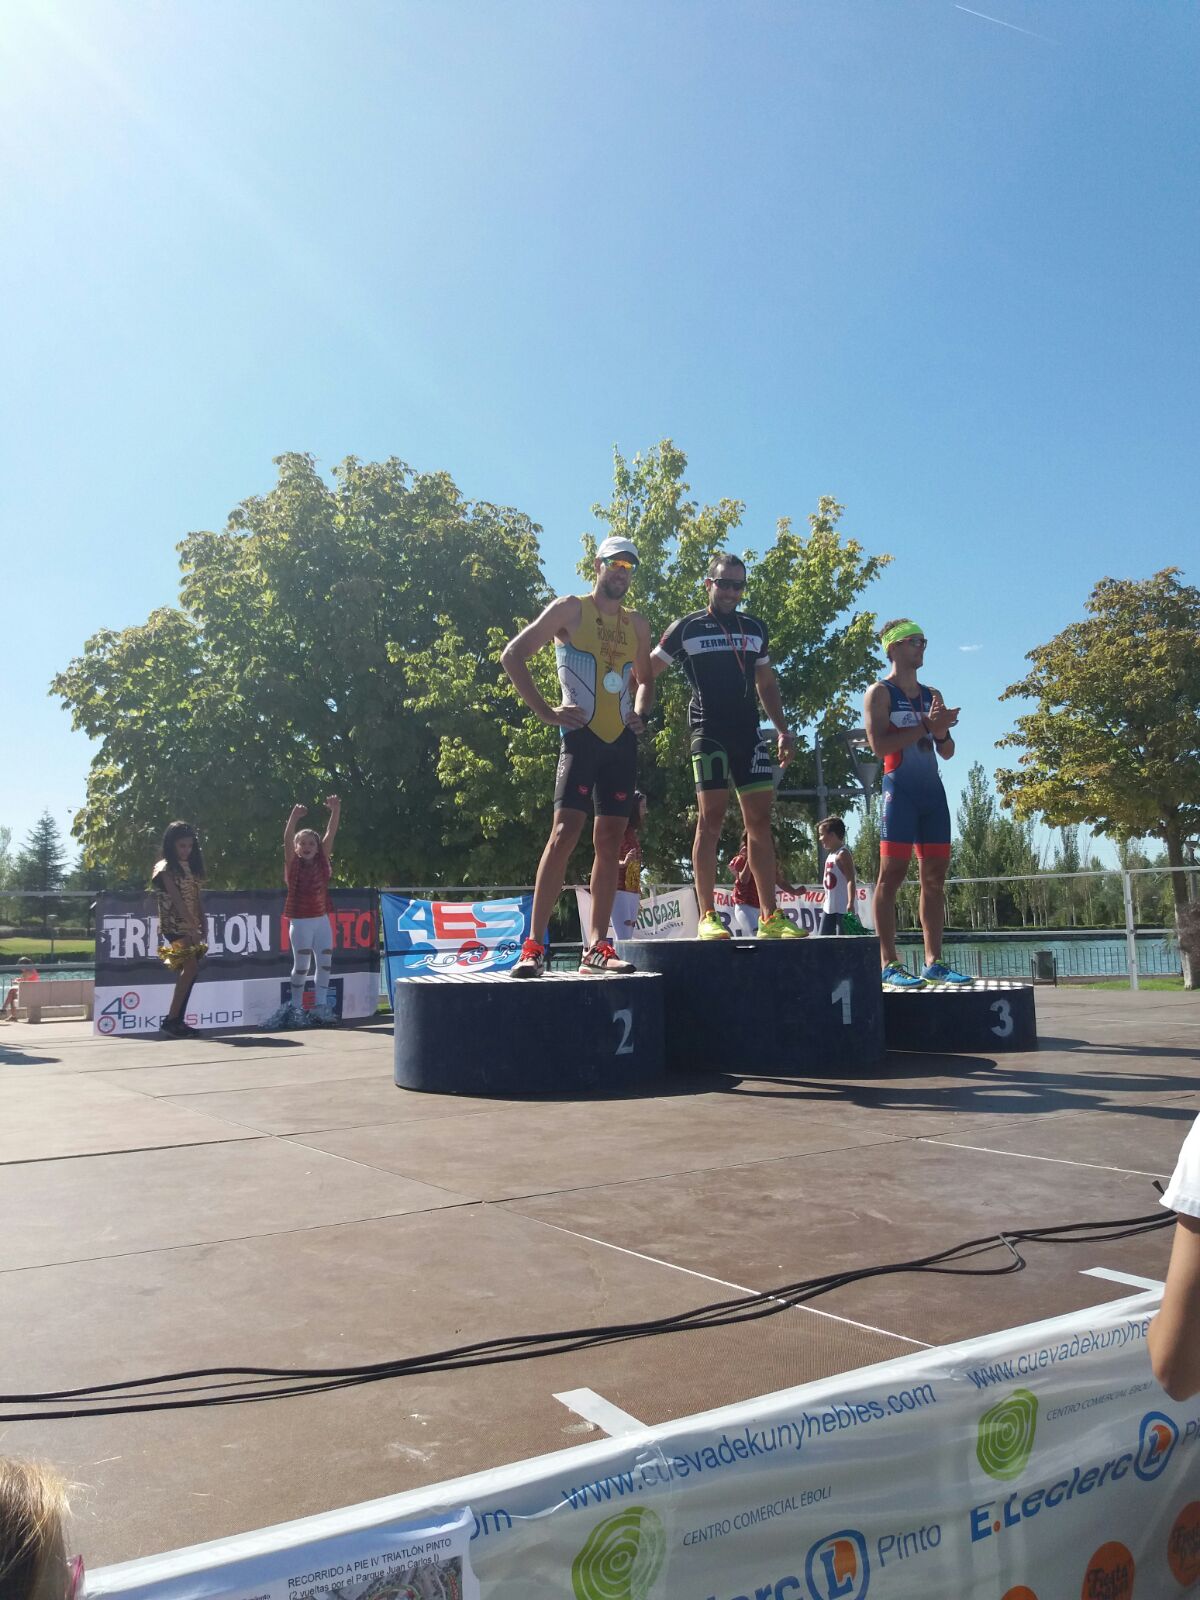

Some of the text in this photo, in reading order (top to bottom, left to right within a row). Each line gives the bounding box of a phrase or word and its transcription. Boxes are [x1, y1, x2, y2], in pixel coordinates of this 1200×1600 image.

[831, 979, 852, 1026] 1
[990, 998, 1014, 1038] 3
[612, 1008, 634, 1055] 2
[1046, 1402, 1081, 1422] CENTRO
[970, 1451, 1134, 1543] E.Leclerc
[683, 1517, 731, 1547] CENTRO
[733, 1496, 799, 1531] COMERCIAL
[287, 1566, 344, 1588] RECORRIDO
[346, 1564, 353, 1573] A
[354, 1559, 369, 1571] PIE
[370, 1556, 379, 1567] IV
[425, 1537, 452, 1551] PINTO
[878, 1523, 942, 1568] Pinto
[331, 1579, 346, 1592] por
[347, 1576, 354, 1585] el
[356, 1567, 385, 1583] Parque
[386, 1564, 406, 1575] Juan
[407, 1557, 432, 1570] Carlos
